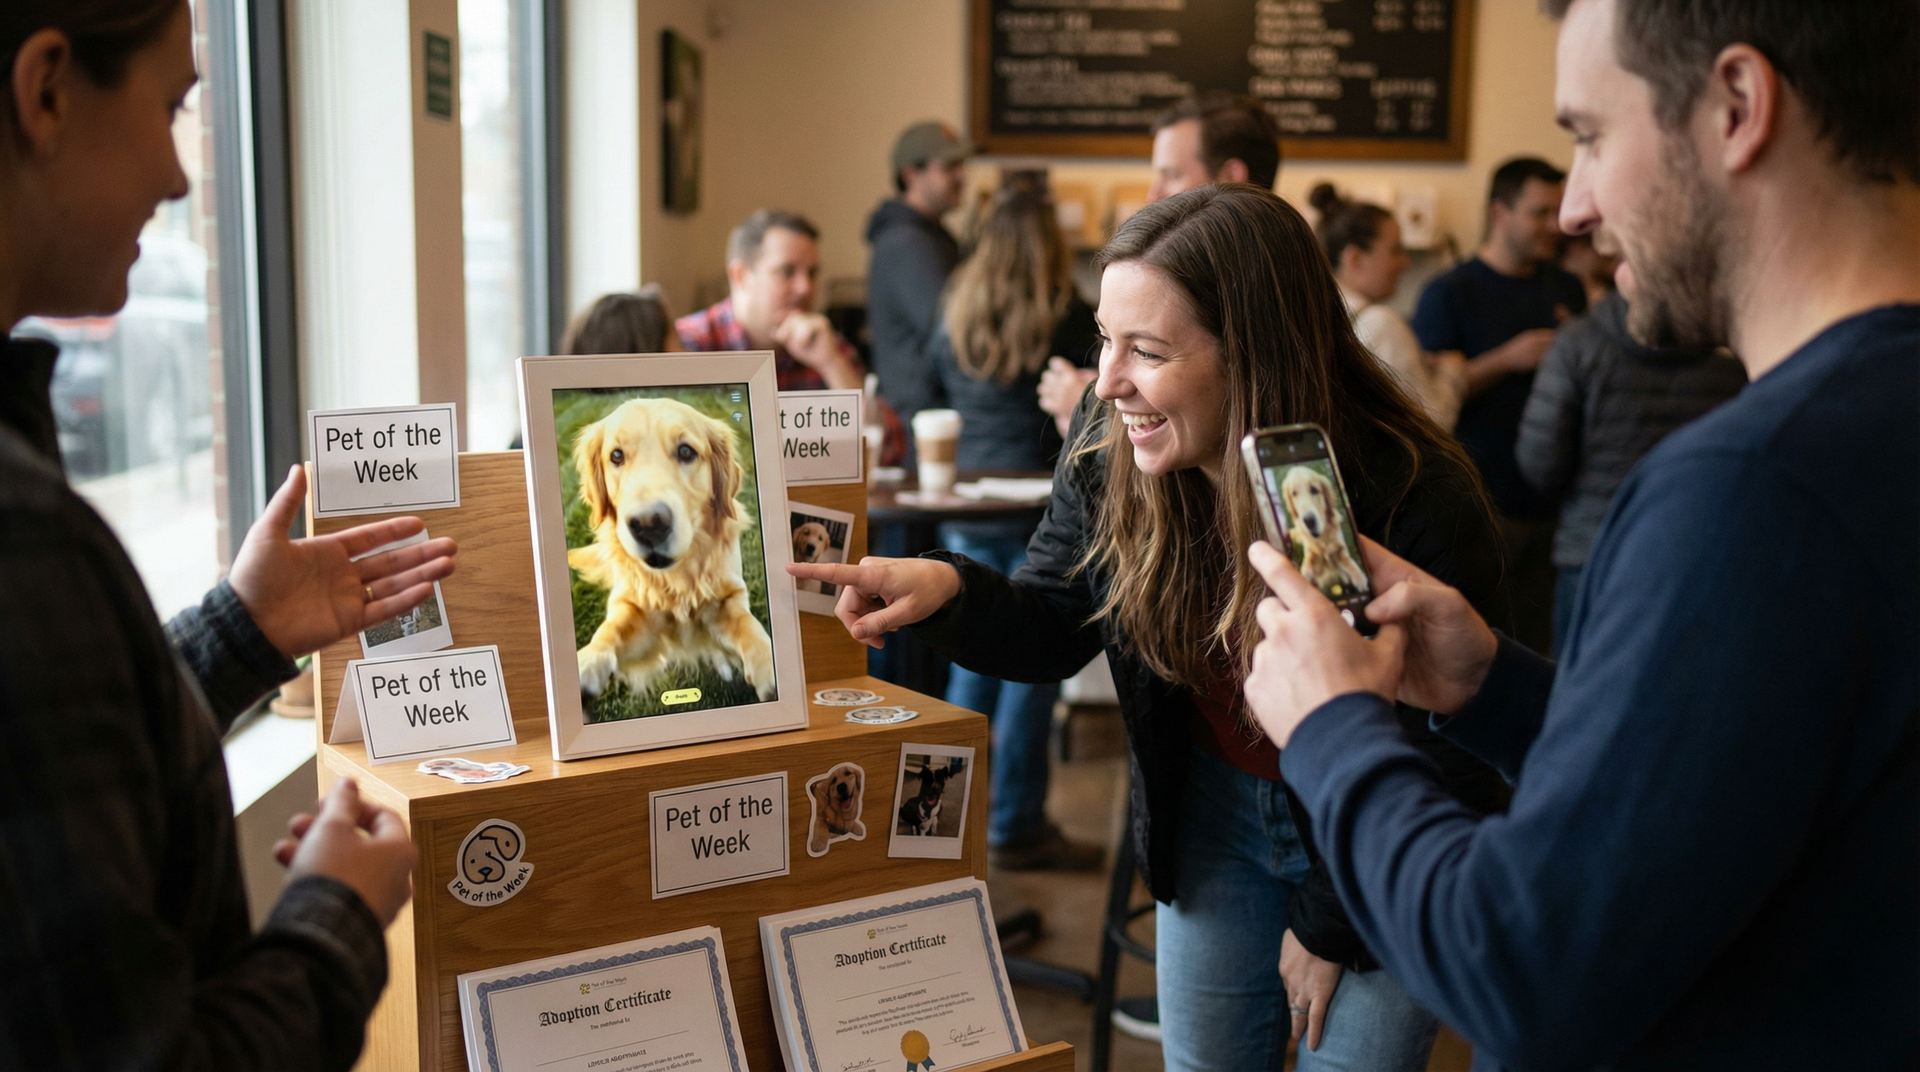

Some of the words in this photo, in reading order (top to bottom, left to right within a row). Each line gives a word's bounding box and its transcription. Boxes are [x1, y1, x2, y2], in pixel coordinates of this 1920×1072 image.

[794, 406, 813, 428] of
[820, 406, 850, 427] the
[326, 427, 364, 452] Pet
[373, 424, 395, 449] of
[405, 423, 441, 447] the
[354, 457, 418, 484] Week
[372, 673, 410, 699] Pet
[419, 668, 441, 693] of
[450, 665, 487, 689] the
[404, 700, 469, 728] Week
[666, 805, 701, 832] Pet
[709, 798, 731, 824] of
[738, 795, 773, 819] the
[691, 829, 750, 860] Week
[453, 881, 470, 899] Pet
[471, 891, 484, 902] of
[486, 890, 503, 902] the
[834, 947, 887, 968] Adoption
[889, 933, 947, 956] Certificate
[538, 1004, 600, 1028] Adoption
[604, 988, 672, 1013] Certificate
